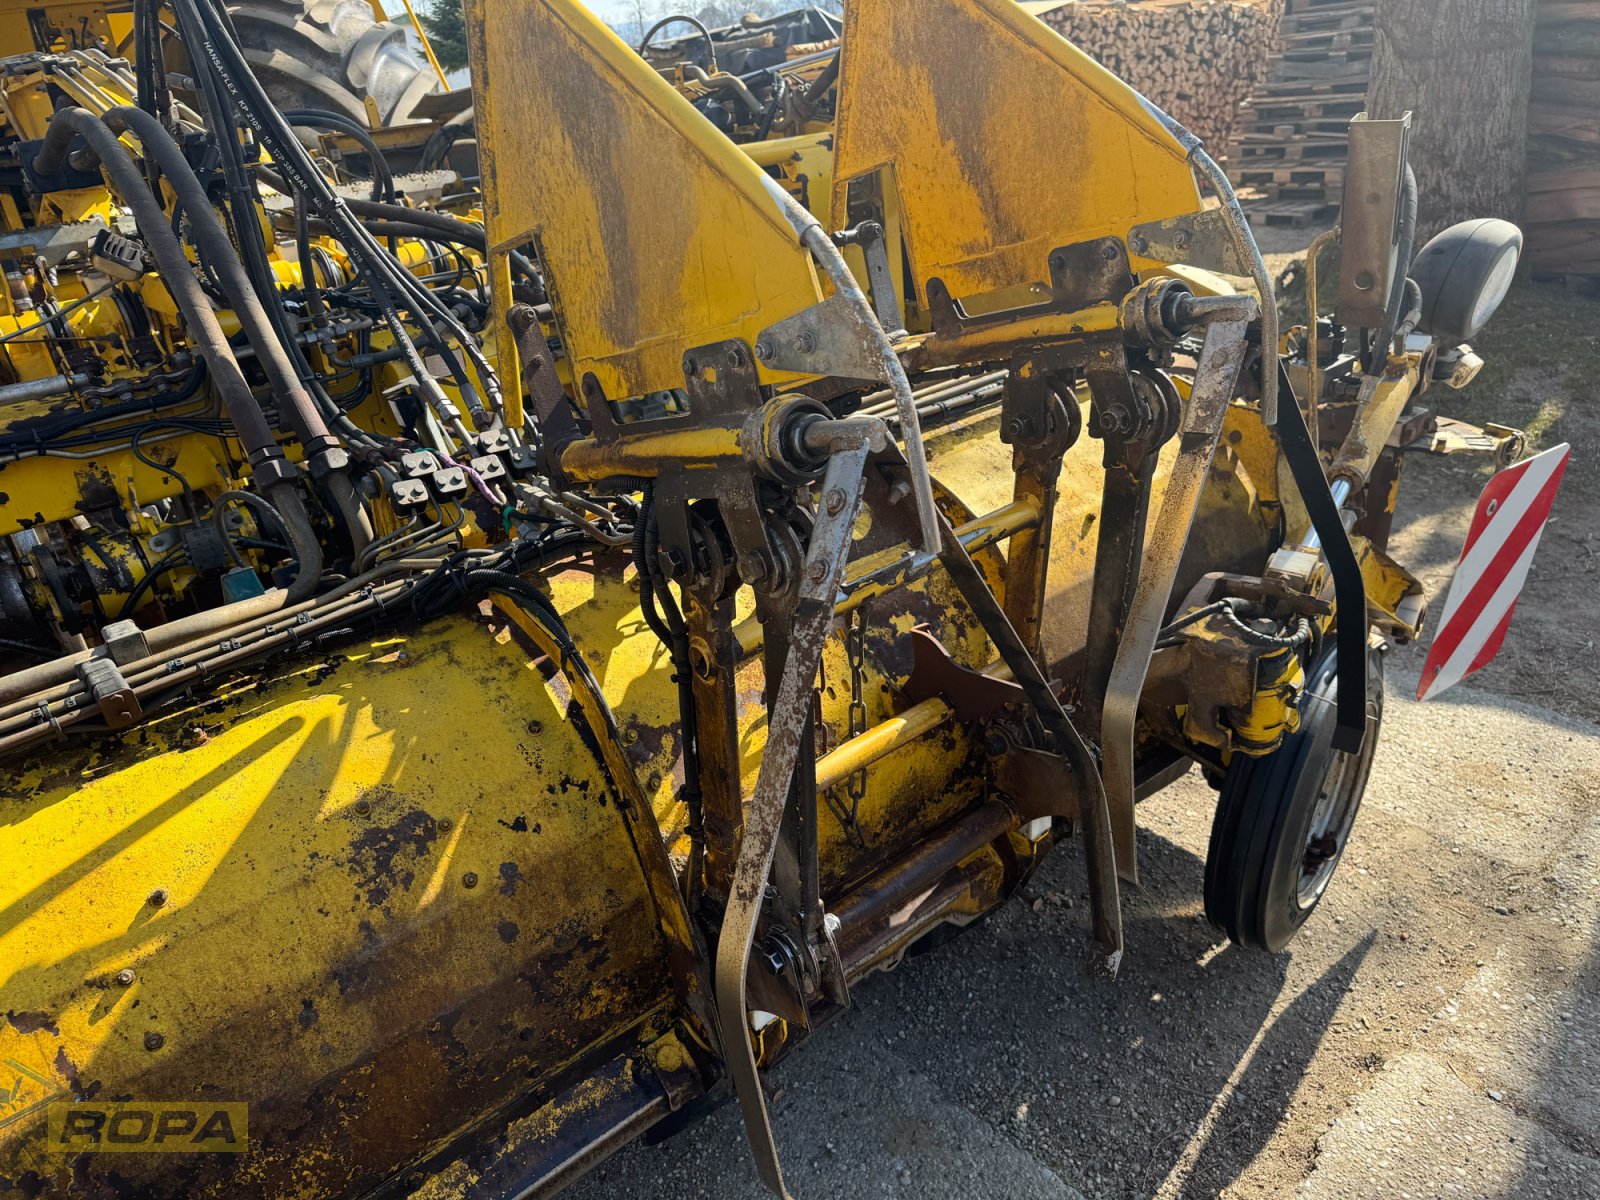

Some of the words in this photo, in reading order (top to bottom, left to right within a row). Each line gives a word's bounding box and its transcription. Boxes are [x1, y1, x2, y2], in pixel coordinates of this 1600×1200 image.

[203, 41, 239, 96] HANSA-FLEX
[237, 99, 249, 112] KP
[246, 112, 262, 131] 210S
[293, 174, 309, 191] BAR
